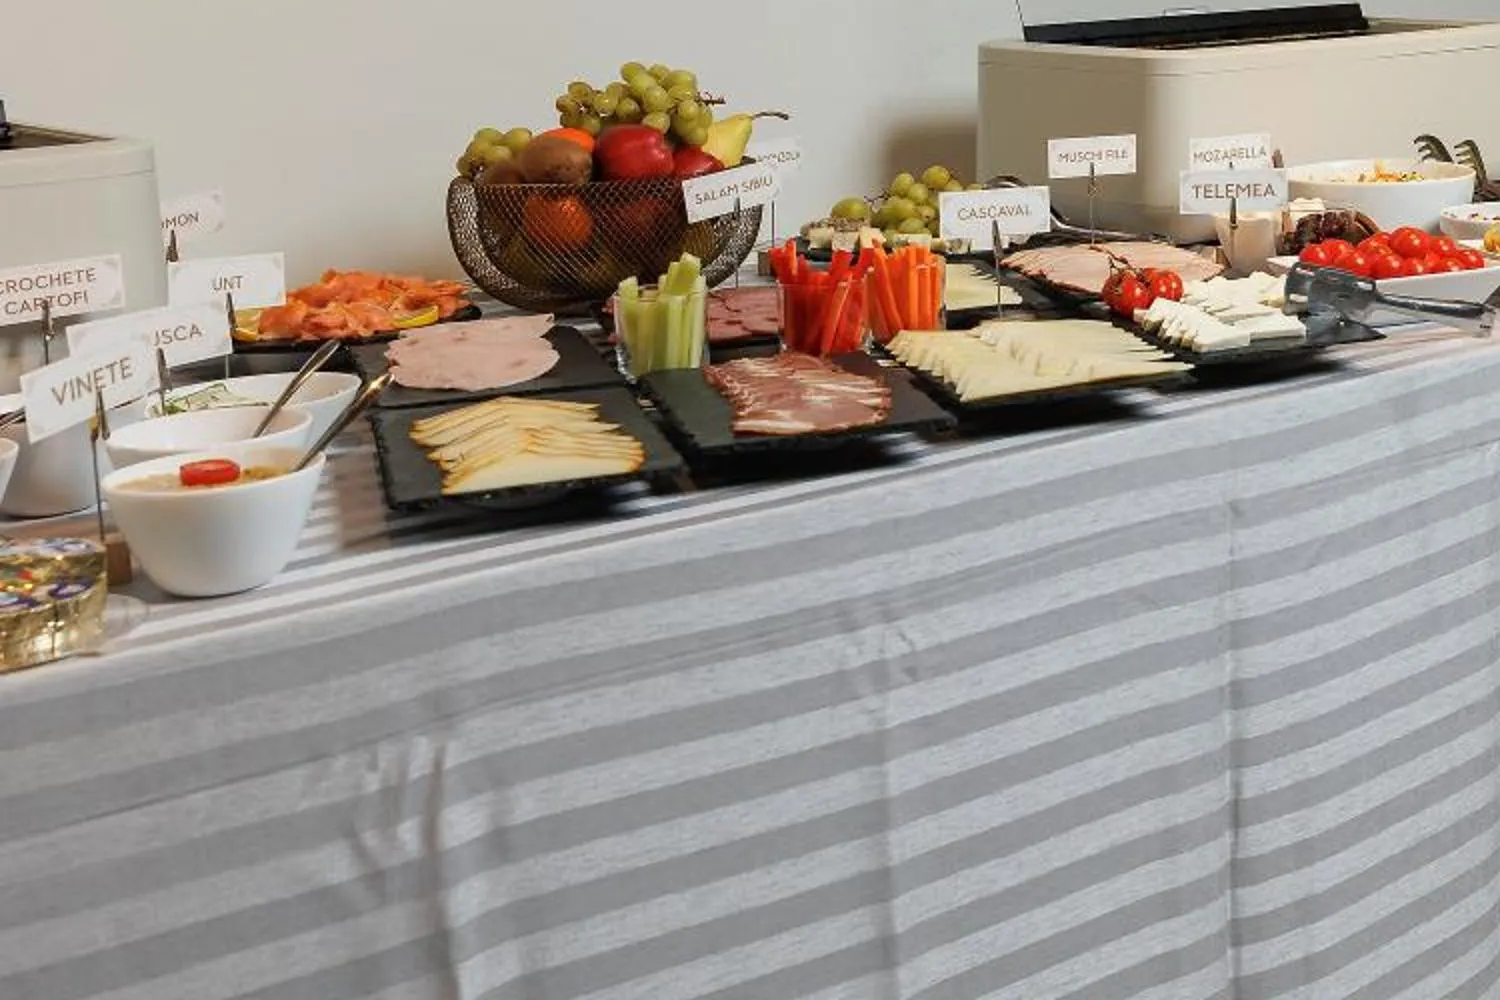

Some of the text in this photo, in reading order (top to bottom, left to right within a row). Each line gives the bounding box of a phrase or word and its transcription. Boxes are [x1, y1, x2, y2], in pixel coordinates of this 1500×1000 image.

[695, 183, 739, 205] SALAM
[1192, 183, 1276, 199] TELEMEA
[160, 212, 199, 229] MON
[958, 204, 1030, 221] CASCAVAL
[212, 275, 243, 291] UNT
[4, 290, 89, 315] CARTOFI
[51, 356, 134, 405] VINETE
